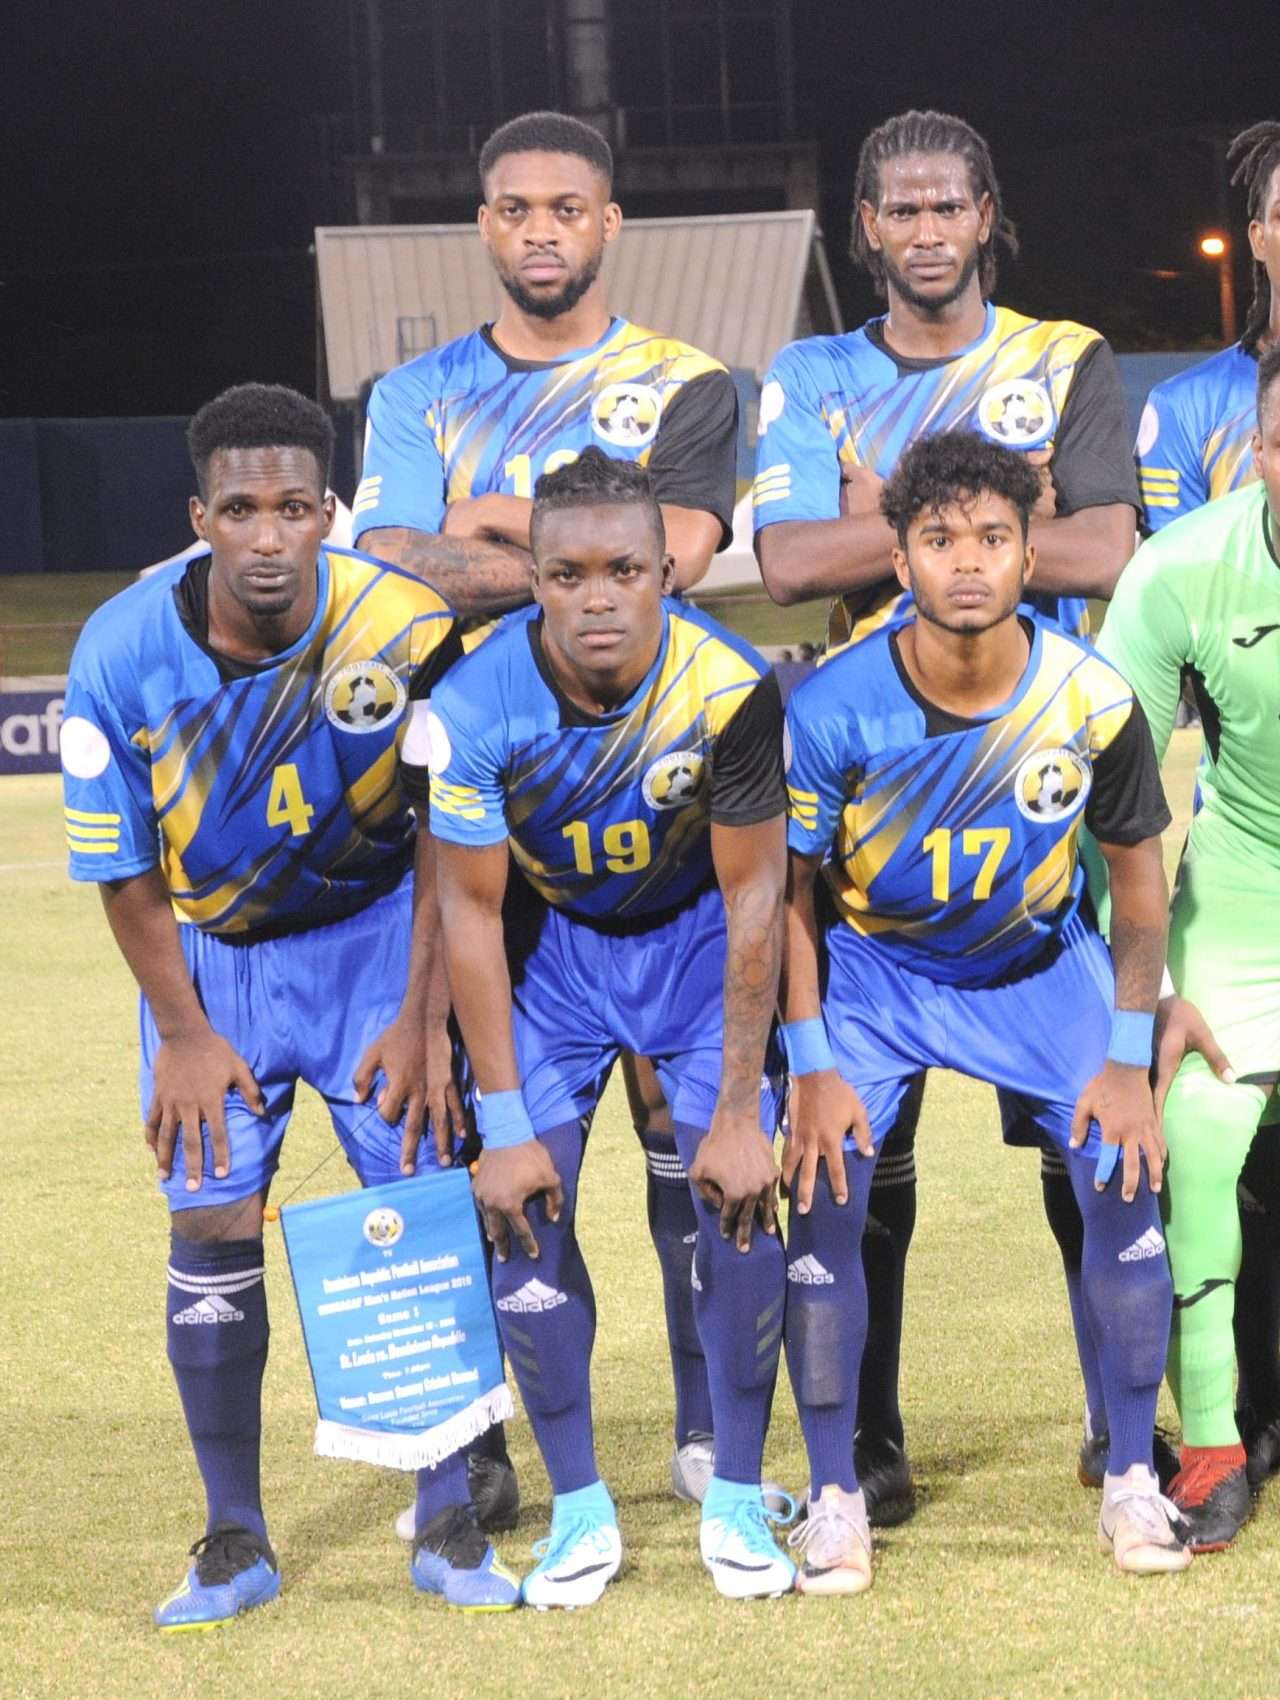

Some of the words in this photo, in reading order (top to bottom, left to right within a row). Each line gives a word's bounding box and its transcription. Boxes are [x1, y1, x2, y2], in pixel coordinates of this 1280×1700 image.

[504, 448, 580, 499] 1
[264, 763, 314, 837] 4
[561, 818, 651, 876] 19
[922, 826, 1011, 903] 17
[172, 1309, 246, 1325] adidas
[496, 1290, 569, 1313] adidas
